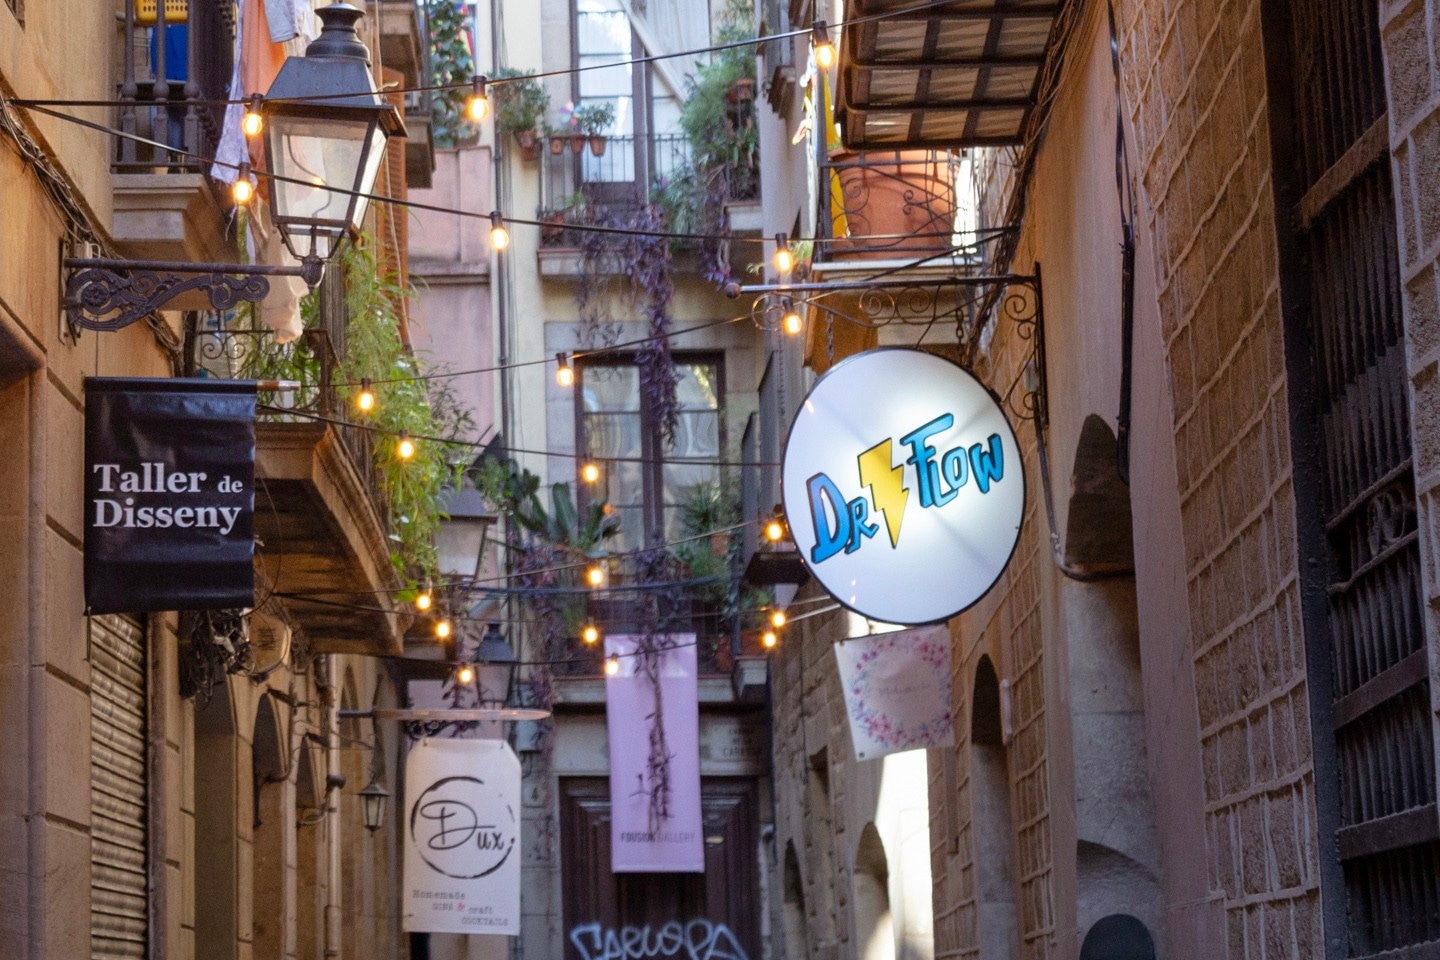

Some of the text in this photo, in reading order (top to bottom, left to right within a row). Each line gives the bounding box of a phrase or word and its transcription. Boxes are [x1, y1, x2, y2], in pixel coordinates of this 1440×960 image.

[93, 462, 243, 493] Taller de
[92, 498, 242, 535] Disseny
[412, 889, 466, 900] Homemade
[468, 906, 493, 915] craft
[461, 916, 509, 927] COCKTAILS
